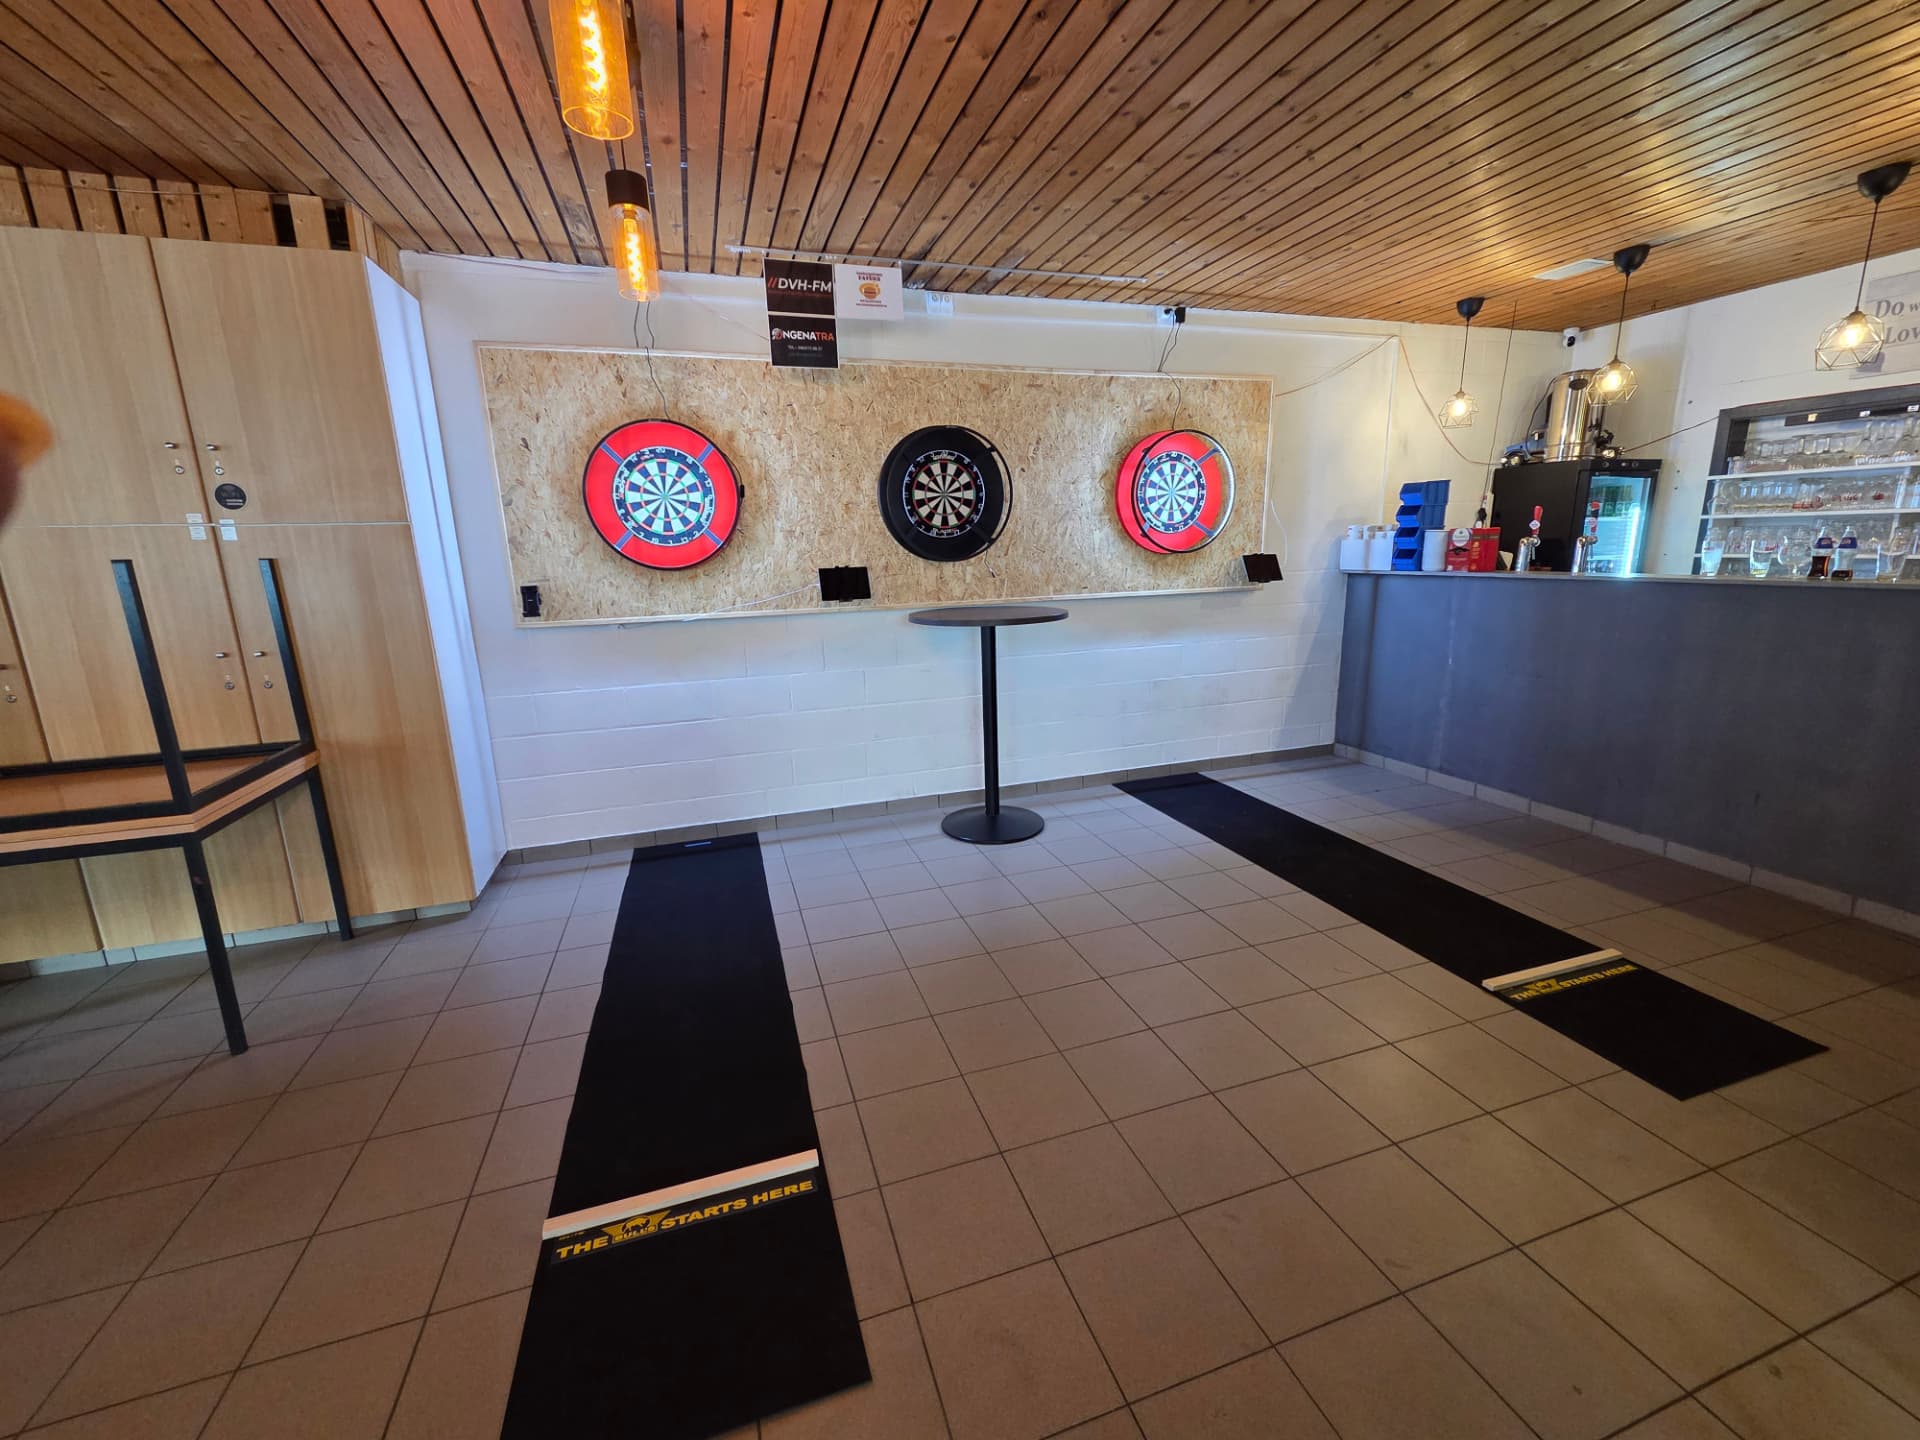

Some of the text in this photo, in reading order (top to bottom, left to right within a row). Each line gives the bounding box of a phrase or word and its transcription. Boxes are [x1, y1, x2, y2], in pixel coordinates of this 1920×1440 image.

[556, 1236, 609, 1259] THE
[660, 1198, 747, 1230] STARTS
[752, 1180, 814, 1205] HERE
